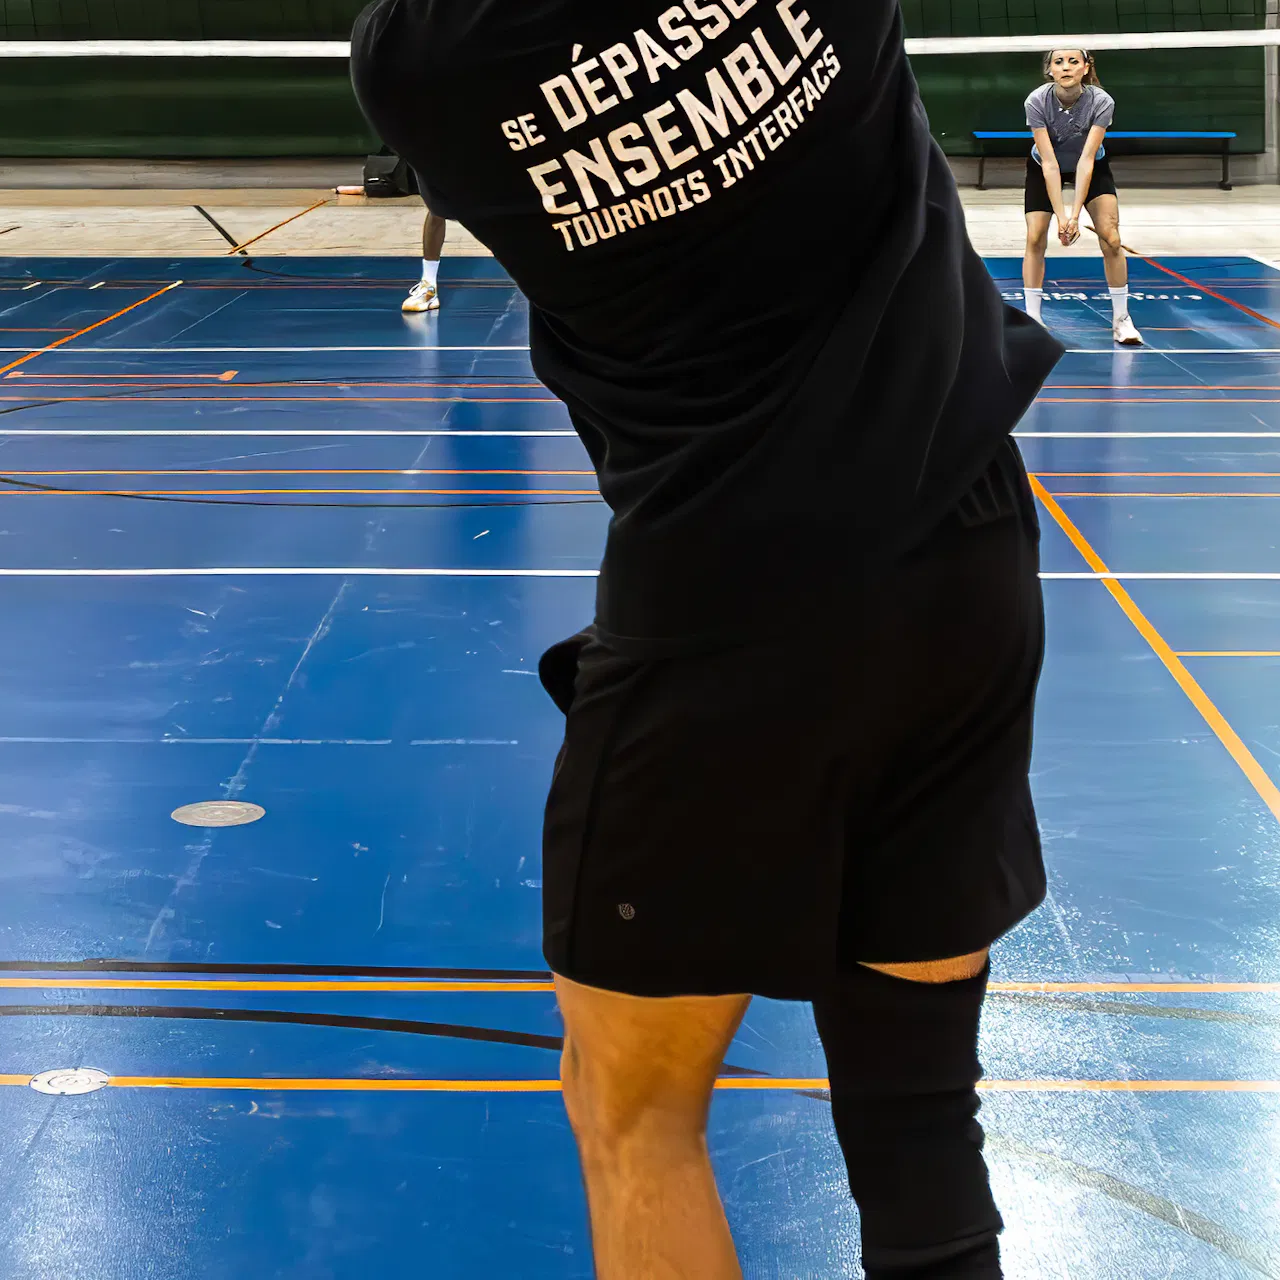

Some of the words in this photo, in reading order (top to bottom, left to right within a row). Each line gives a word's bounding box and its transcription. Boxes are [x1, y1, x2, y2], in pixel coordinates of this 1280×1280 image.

[501, 113, 546, 151] SE
[552, 170, 712, 251] TOURNOIS
[712, 44, 841, 189] INTERFACS
